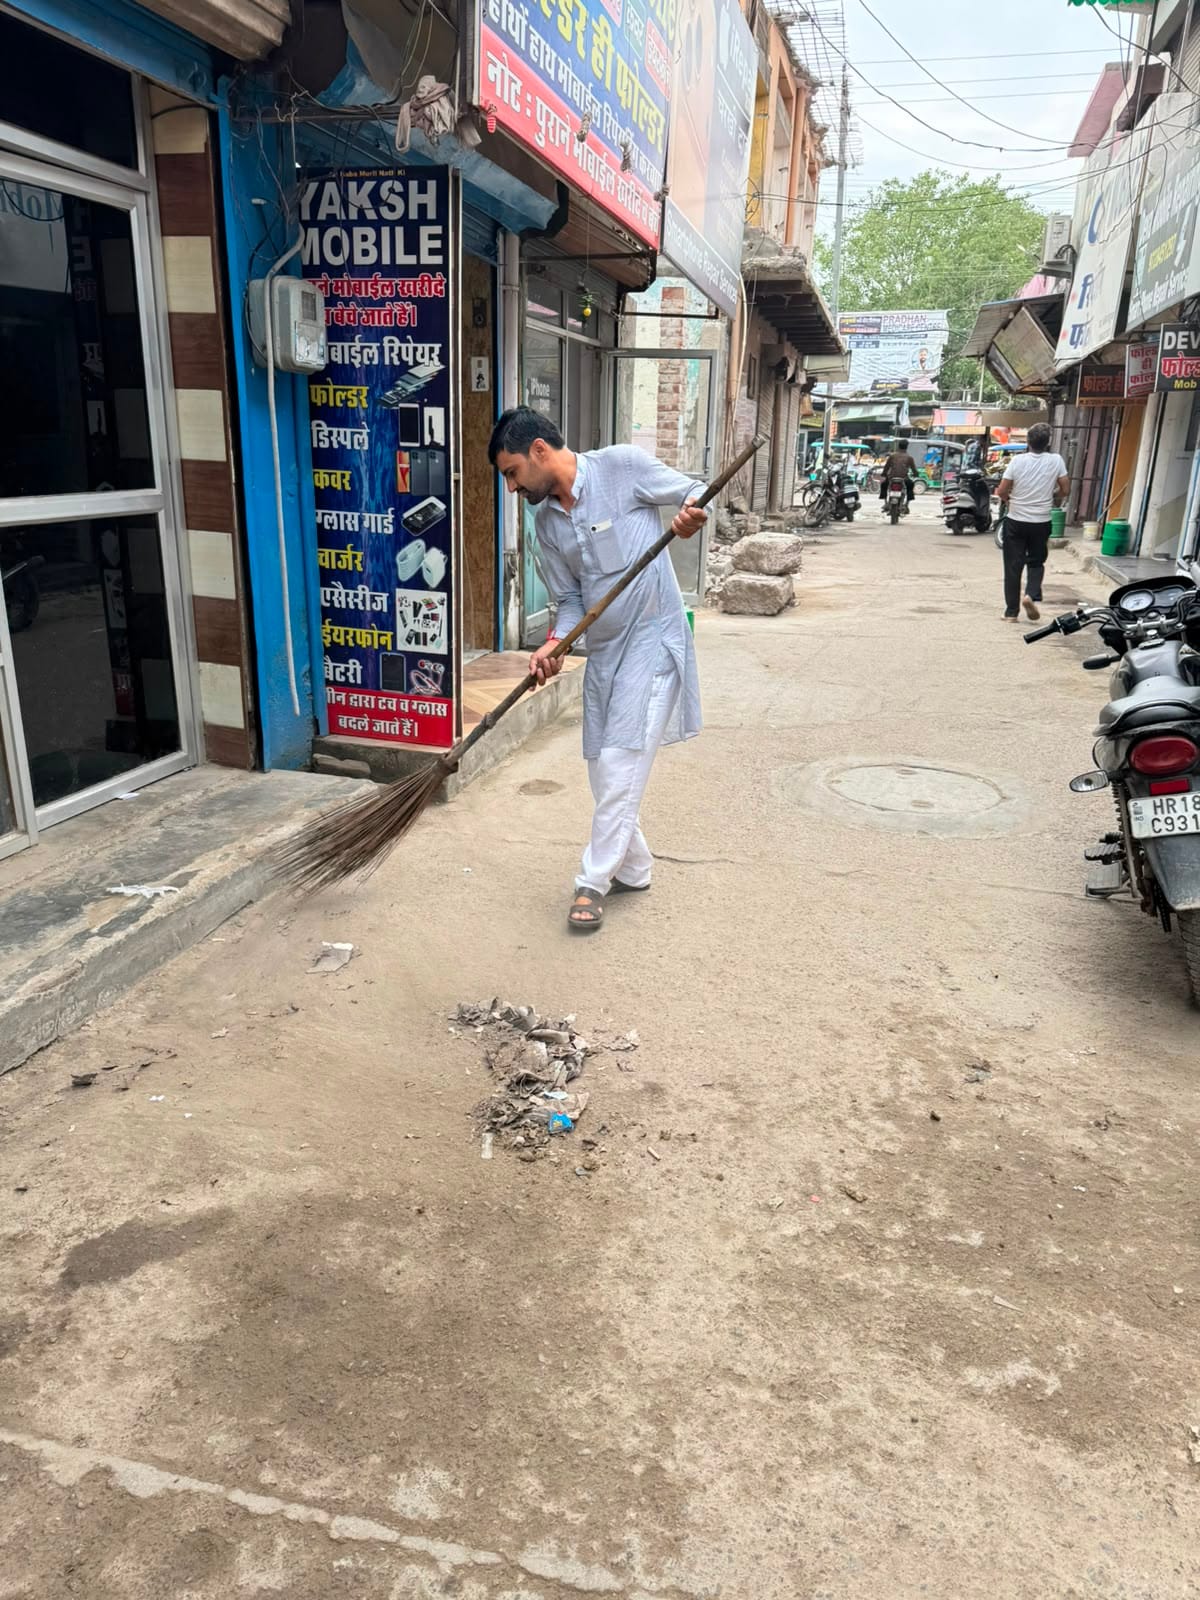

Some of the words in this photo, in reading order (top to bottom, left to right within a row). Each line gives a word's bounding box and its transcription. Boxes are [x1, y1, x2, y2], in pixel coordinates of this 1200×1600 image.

[529, 26, 556, 80] हाथ
[591, 13, 615, 92] ही
[616, 53, 665, 154] फोल्डर
[486, 51, 522, 113] नोट
[534, 96, 571, 157] पुराने
[573, 133, 616, 196] मोबाईल
[300, 179, 437, 222] YAKSH
[302, 225, 443, 266] MOBILE
[332, 271, 395, 300] मोबाईल
[398, 271, 446, 298] खरीदे
[333, 301, 358, 327] बेचे
[360, 302, 394, 327] जाते
[382, 335, 442, 367] रिपेयर
[310, 377, 370, 408] फोल्डर
[1173, 378, 1198, 390] Mob
[313, 469, 352, 491] कवर
[315, 509, 360, 532] ग्लास
[361, 507, 395, 535] गार्ड
[321, 618, 394, 651] ईयरफोन
[323, 655, 363, 685] बैटरी
[348, 692, 376, 709] द्वारा
[377, 695, 398, 712] टच
[399, 697, 410, 713] व
[411, 700, 448, 717] ग्लास
[337, 713, 370, 732] बदले
[371, 716, 401, 735] जाते
[1151, 813, 1200, 834] C931
